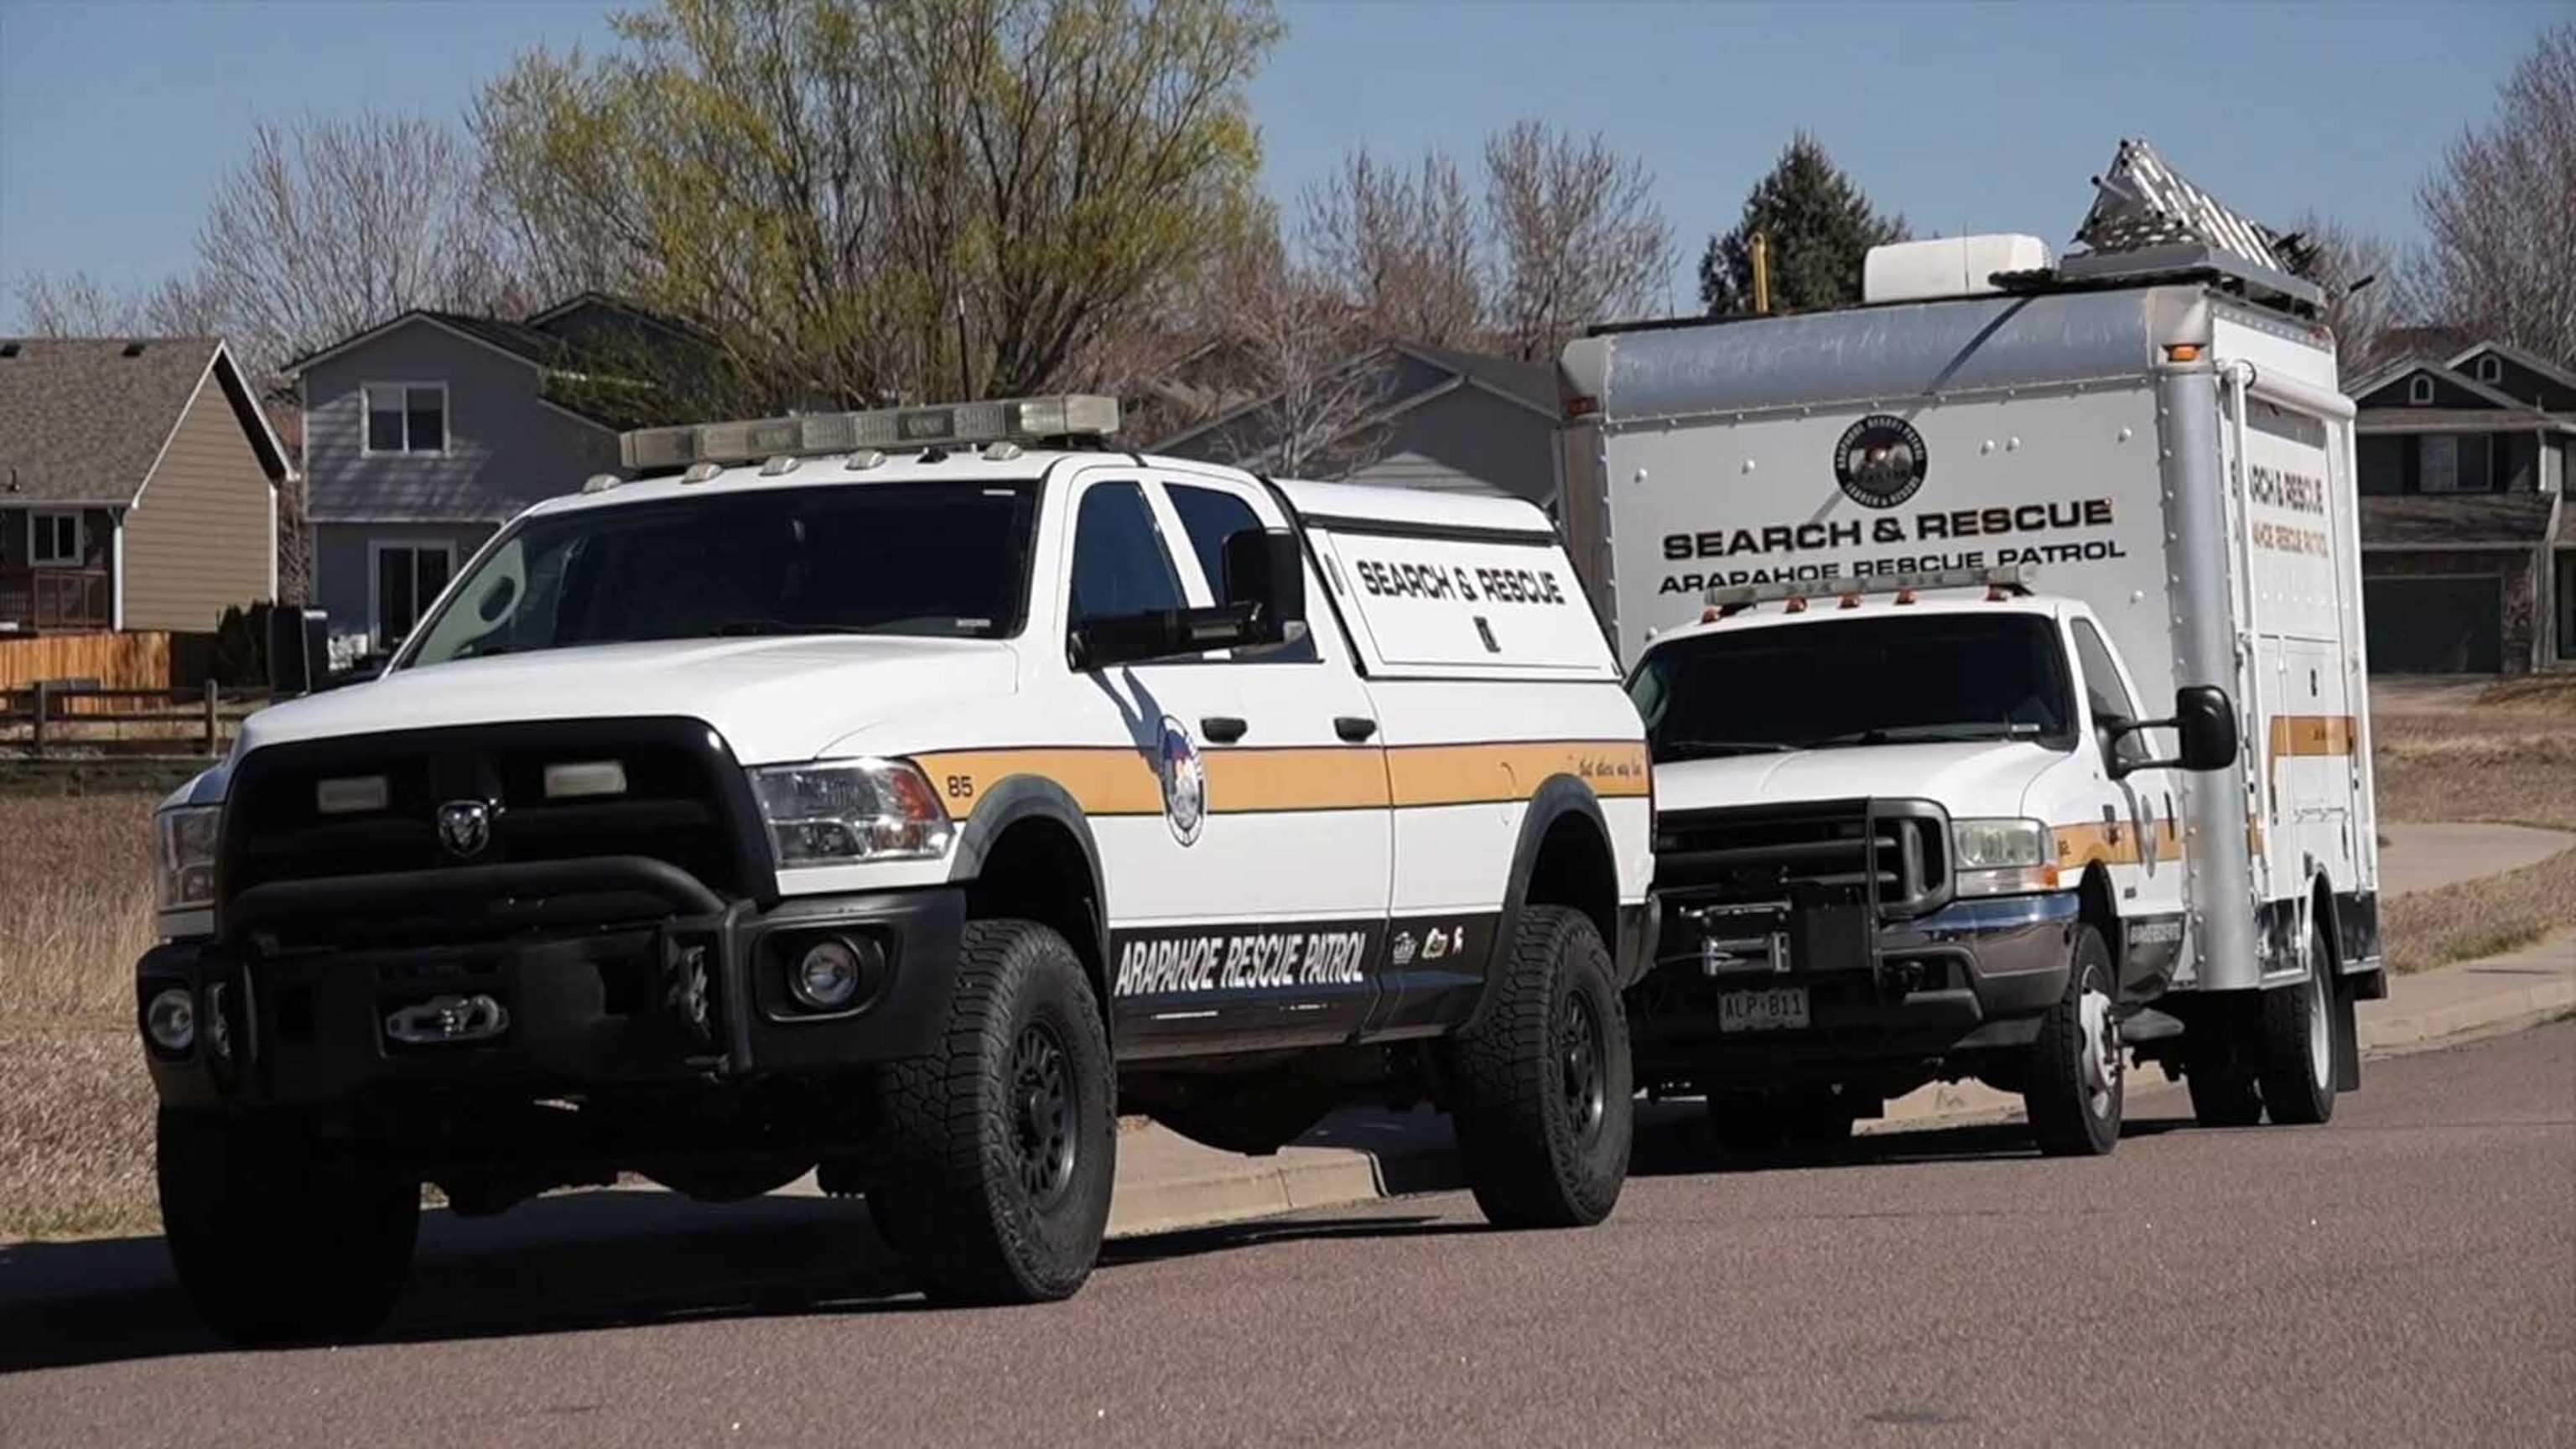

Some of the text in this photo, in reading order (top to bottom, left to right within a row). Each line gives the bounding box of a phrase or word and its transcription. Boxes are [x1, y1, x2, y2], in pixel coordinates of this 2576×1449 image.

[1663, 500, 2113, 561] SEARCH & RESCUE
[1356, 559, 1566, 606] SEARCH & RESCUE
[1659, 540, 2126, 595] ARAPAHOE RESCUE PATROL
[947, 776, 974, 797] 85
[1114, 937, 1223, 997] ARAPAHOE
[1220, 934, 1303, 989] RESCUE
[1299, 932, 1367, 985] PATROL
